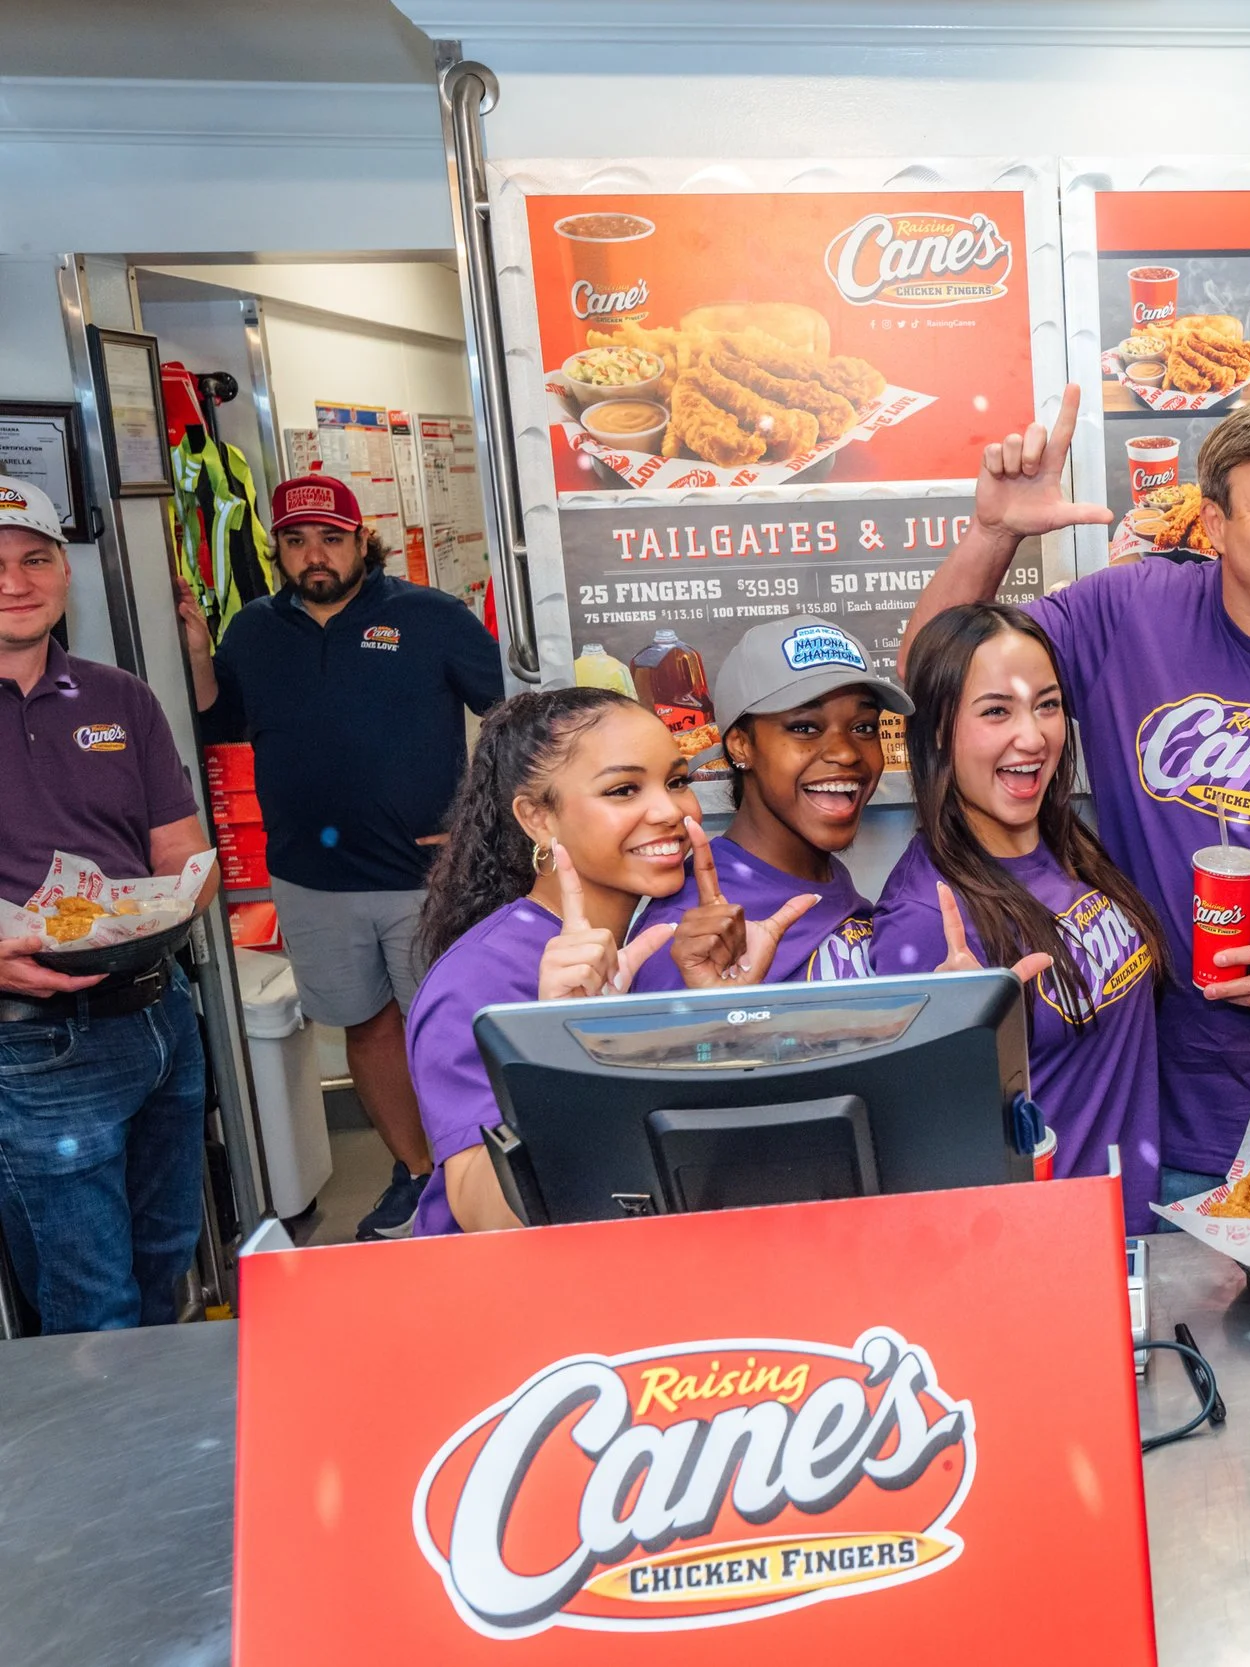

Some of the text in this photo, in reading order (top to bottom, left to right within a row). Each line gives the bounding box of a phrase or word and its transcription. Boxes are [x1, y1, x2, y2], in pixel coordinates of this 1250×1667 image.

[896, 220, 955, 238] Raising
[837, 214, 1010, 299] Cane's
[570, 277, 650, 321] Cane's
[895, 283, 993, 297] CHICKEN FINGERS
[925, 319, 976, 329] RaisingCanes
[1133, 301, 1175, 323] Cane's
[1133, 467, 1175, 490] Cane's
[613, 520, 838, 562] TAILGATES
[858, 519, 885, 551] &
[579, 585, 608, 605] 25
[615, 579, 722, 604] FINGERS
[737, 578, 799, 597] $39.99
[830, 575, 859, 595] 50
[584, 612, 601, 624] 75
[603, 609, 657, 623] FINGERS
[661, 607, 703, 620] $113.16
[712, 605, 735, 618] 100
[737, 603, 789, 617] FINGERS
[796, 602, 837, 615] $135.80
[847, 599, 872, 612] Each
[363, 626, 401, 641] Cane's
[799, 628, 820, 636] 2024
[361, 640, 398, 652] ONE LOVE
[794, 637, 849, 652] NATIONAL
[794, 650, 862, 664] CHAMPIONS
[76, 723, 125, 749] Cane's
[1075, 895, 1111, 932] Raising
[1192, 894, 1246, 925] Cane's
[1201, 900, 1226, 911] Raising
[1110, 961, 1139, 990] CHICKEN
[747, 1011, 771, 1020] NCR
[636, 1356, 810, 1416] Raising
[449, 1335, 966, 1629] Cane's
[629, 1539, 917, 1595] CHICKEN FINGERS
